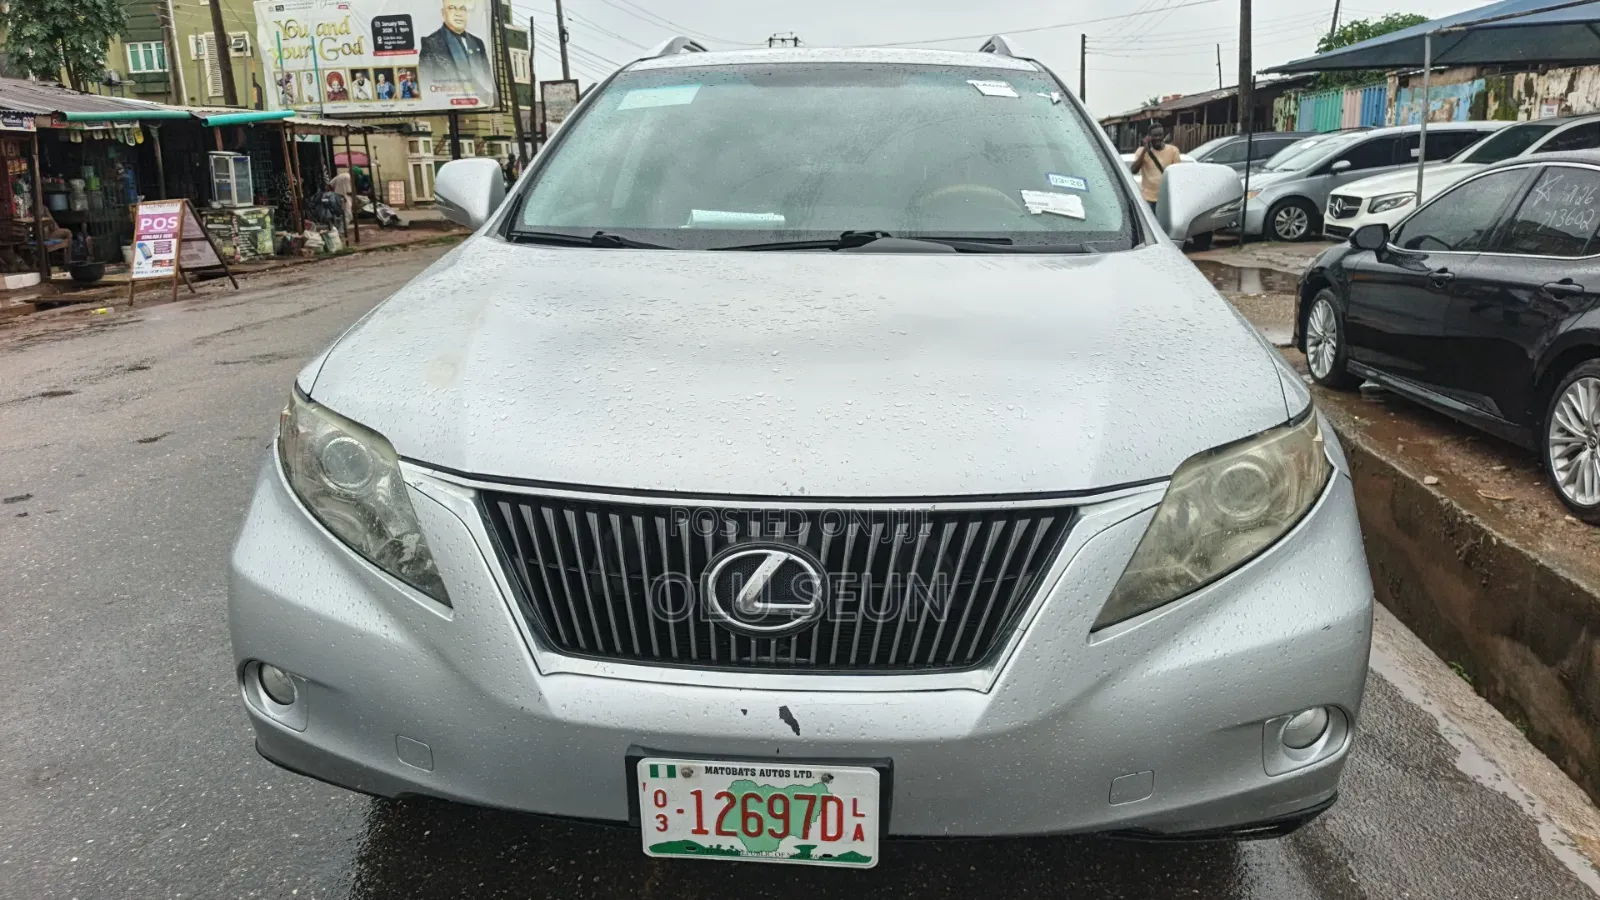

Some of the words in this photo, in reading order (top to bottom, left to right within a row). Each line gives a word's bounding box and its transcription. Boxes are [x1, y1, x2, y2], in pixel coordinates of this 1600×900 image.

[273, 18, 310, 40] You
[316, 15, 351, 37] and
[319, 35, 364, 61] God
[140, 216, 178, 230] POS
[704, 765, 757, 777] MATOBATS
[758, 768, 791, 778] AUTOS
[793, 769, 815, 779] LTD.
